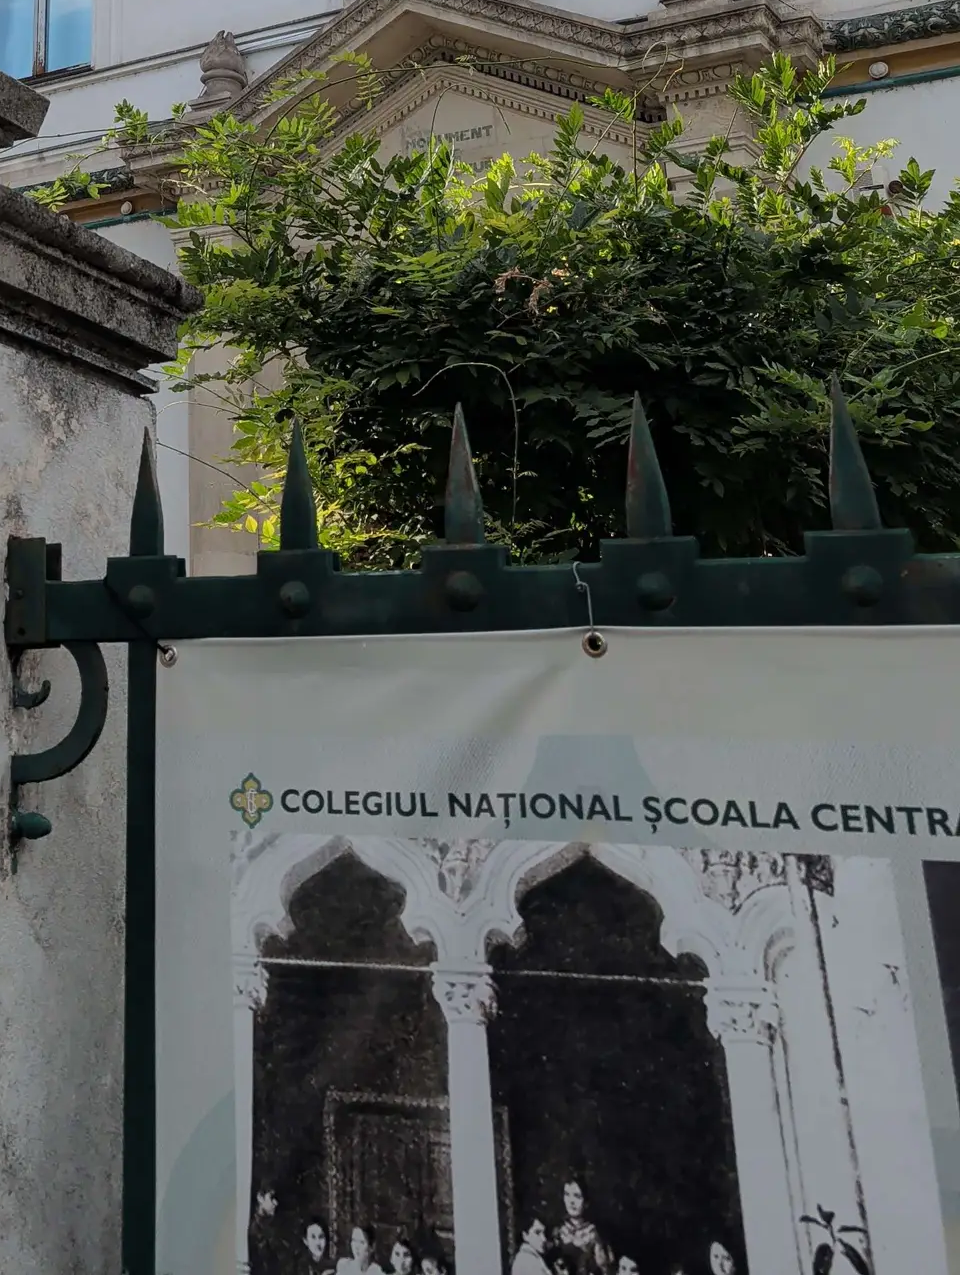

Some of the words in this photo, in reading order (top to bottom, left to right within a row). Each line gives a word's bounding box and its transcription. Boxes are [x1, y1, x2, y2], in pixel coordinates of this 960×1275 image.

[280, 788, 439, 818] COLEGIUL
[448, 791, 633, 829] NAȚIONAL
[642, 795, 801, 834] ȘCOALA
